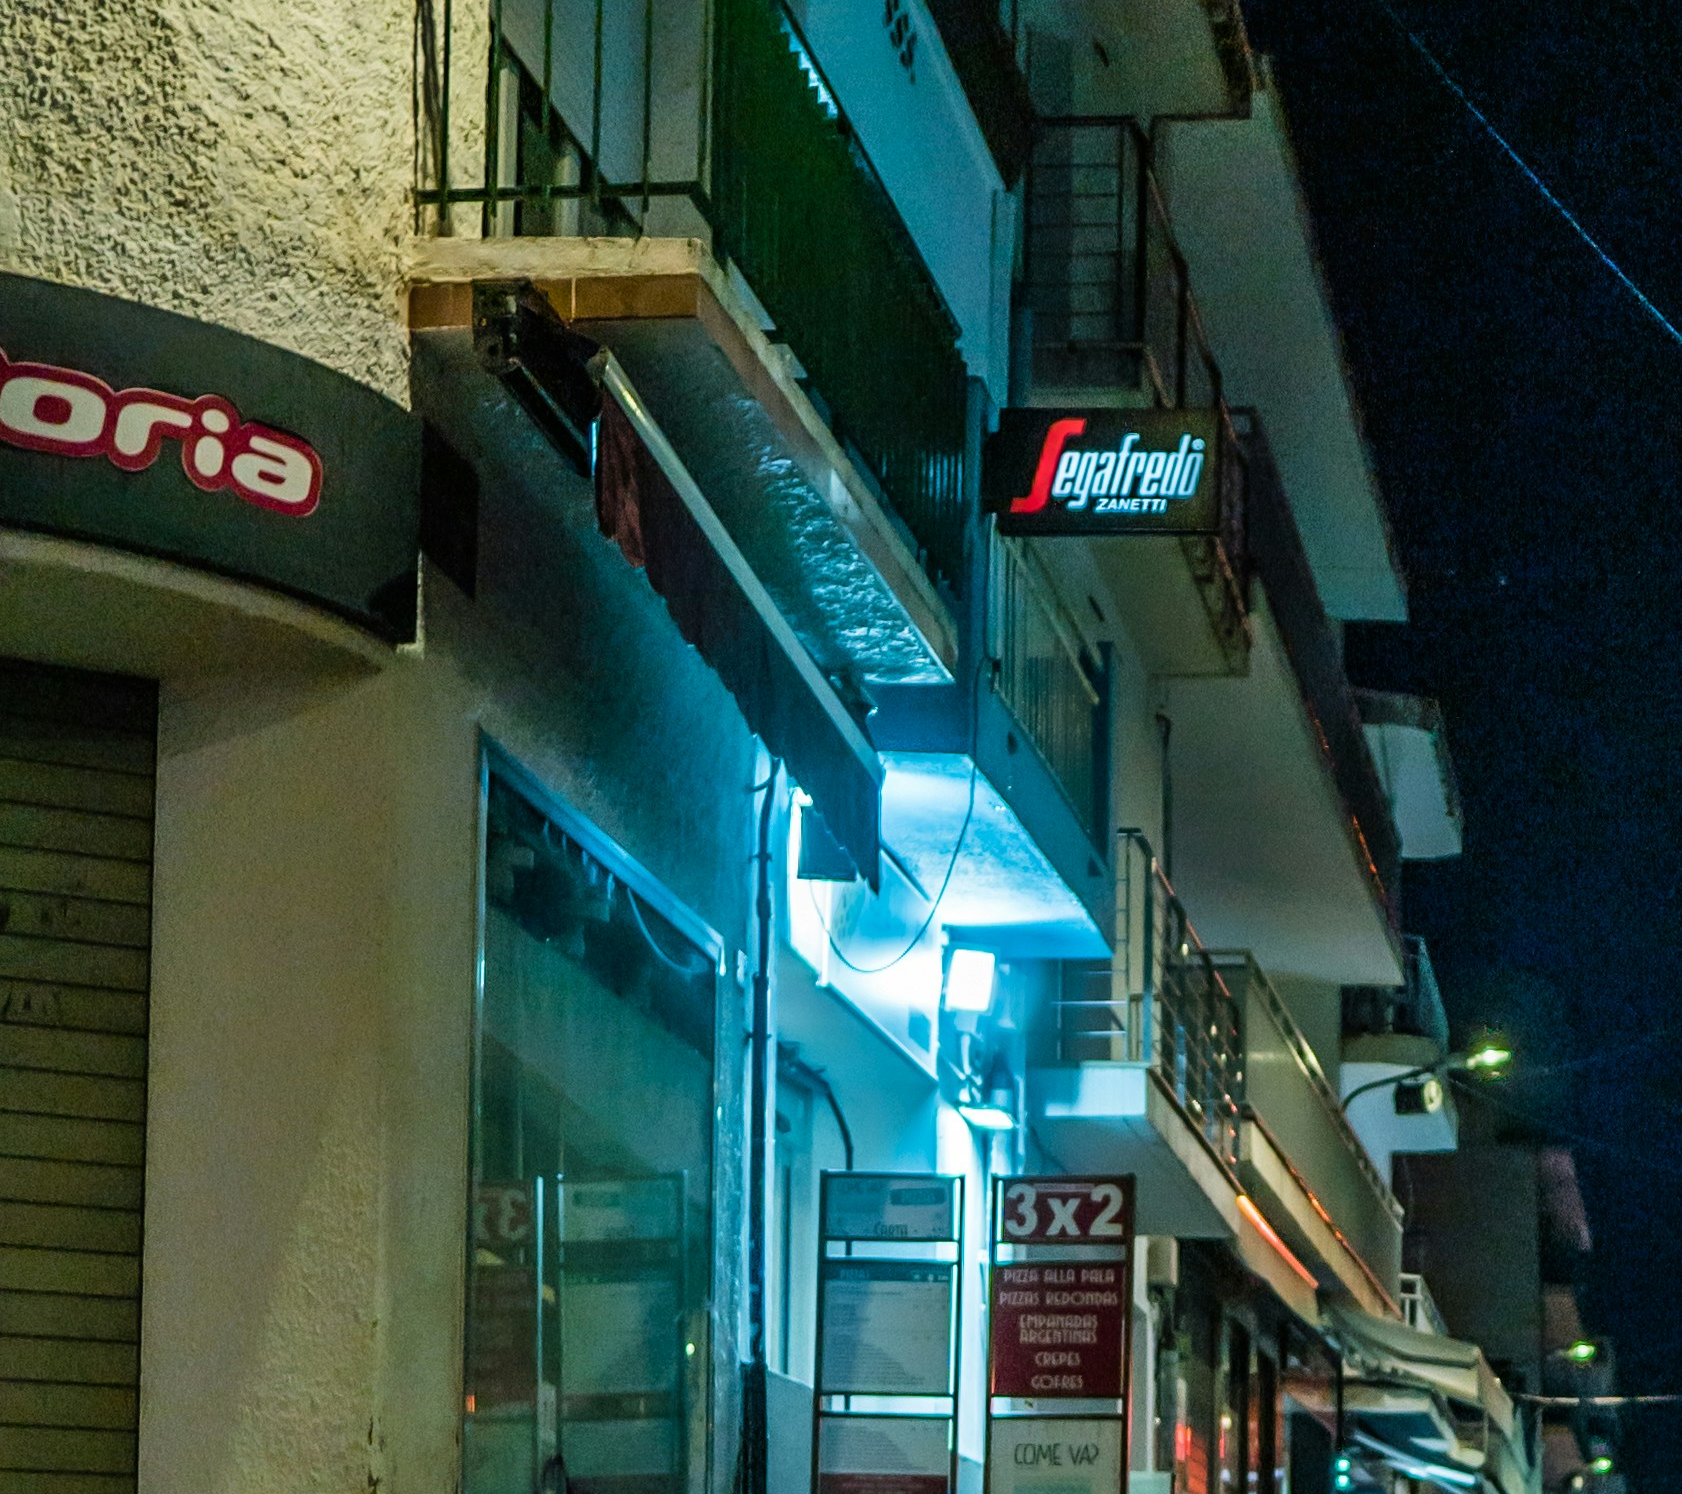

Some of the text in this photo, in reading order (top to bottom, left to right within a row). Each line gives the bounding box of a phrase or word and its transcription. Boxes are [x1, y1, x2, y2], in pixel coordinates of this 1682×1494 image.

[1010, 417, 1206, 513] Segafredo
[1095, 497, 1167, 513] ZANETTI
[1003, 1268, 1115, 1283] PIZZA ALLA PALA
[1000, 1291, 1118, 1306] PIZZAS REDONDAS
[1034, 1351, 1081, 1367] CREPES
[1030, 1374, 1083, 1390] GOFRES
[1014, 1442, 1062, 1466] COME
